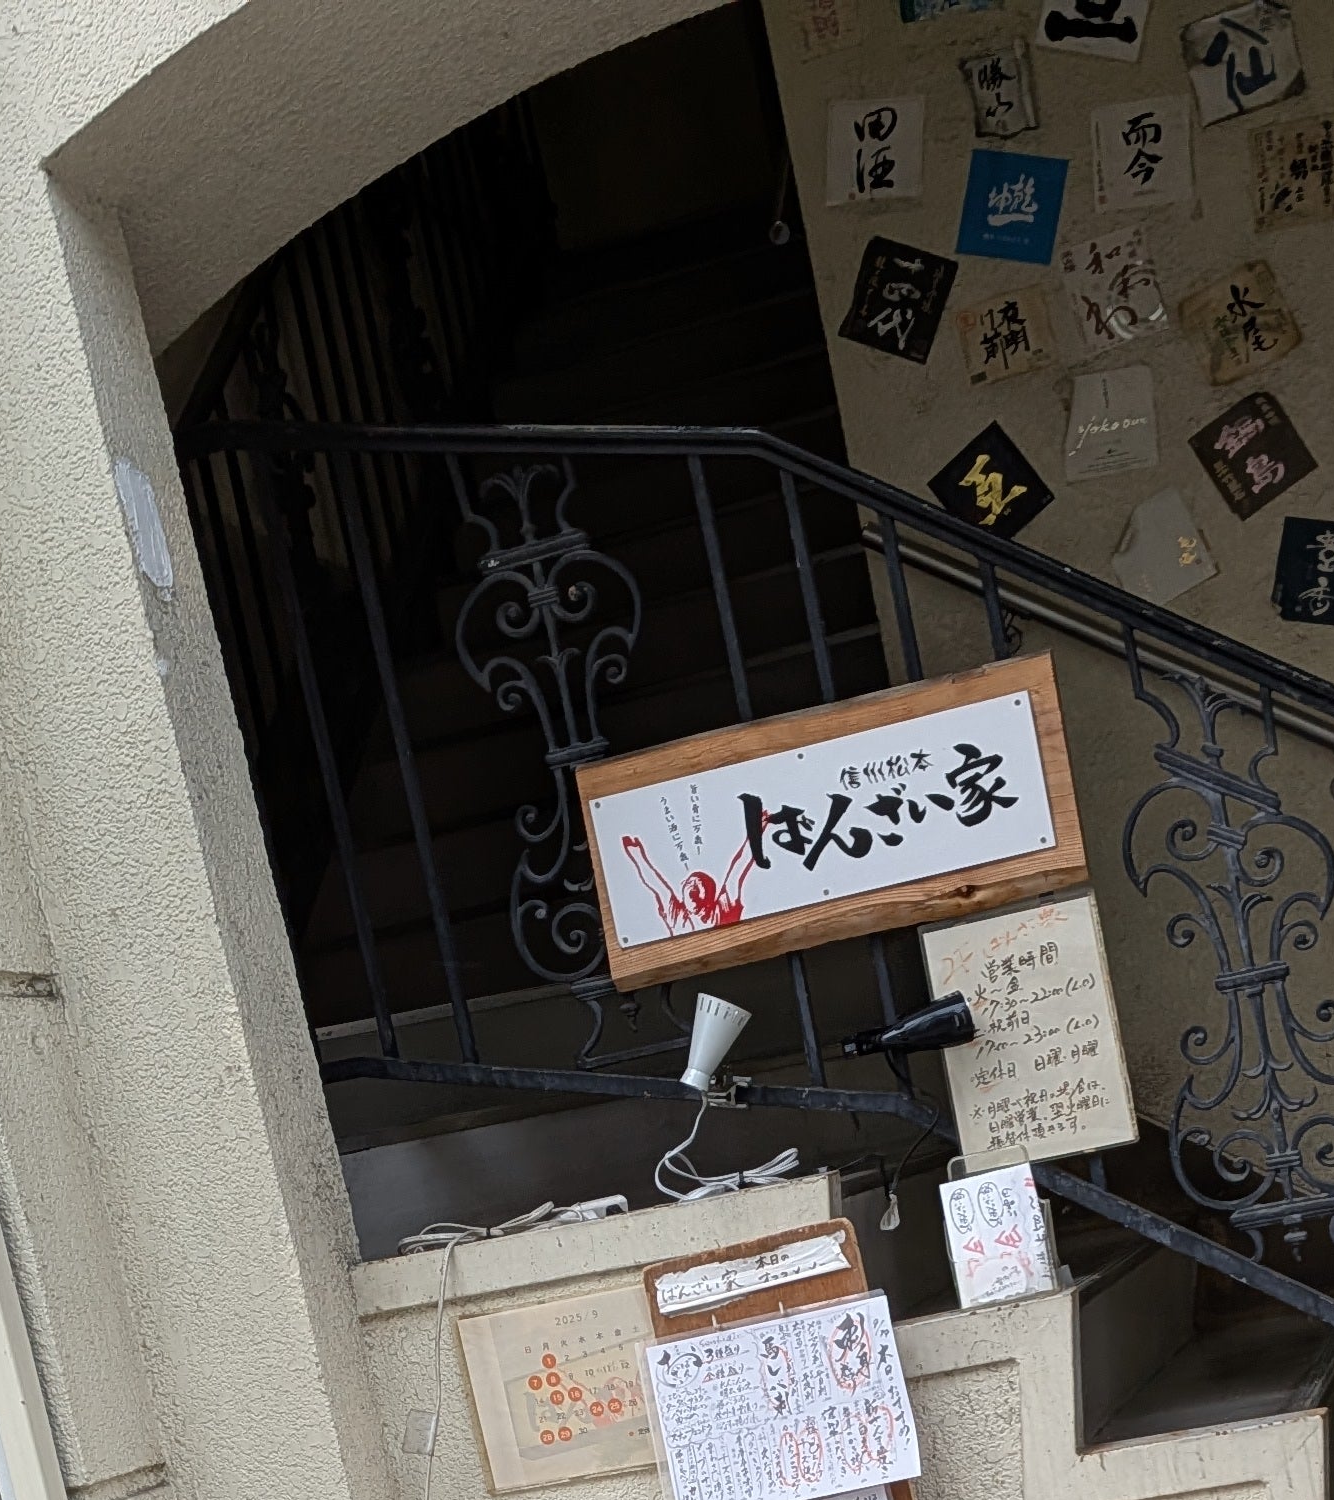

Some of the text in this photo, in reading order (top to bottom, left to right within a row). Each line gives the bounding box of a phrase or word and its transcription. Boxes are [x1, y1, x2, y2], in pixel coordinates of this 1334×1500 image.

[839, 749, 935, 791] 信州松本
[737, 743, 1019, 872] ばんざい家
[981, 942, 1059, 984] 営業時間
[662, 1269, 745, 1302] ばんざい家
[555, 1310, 599, 1326] 2025/9
